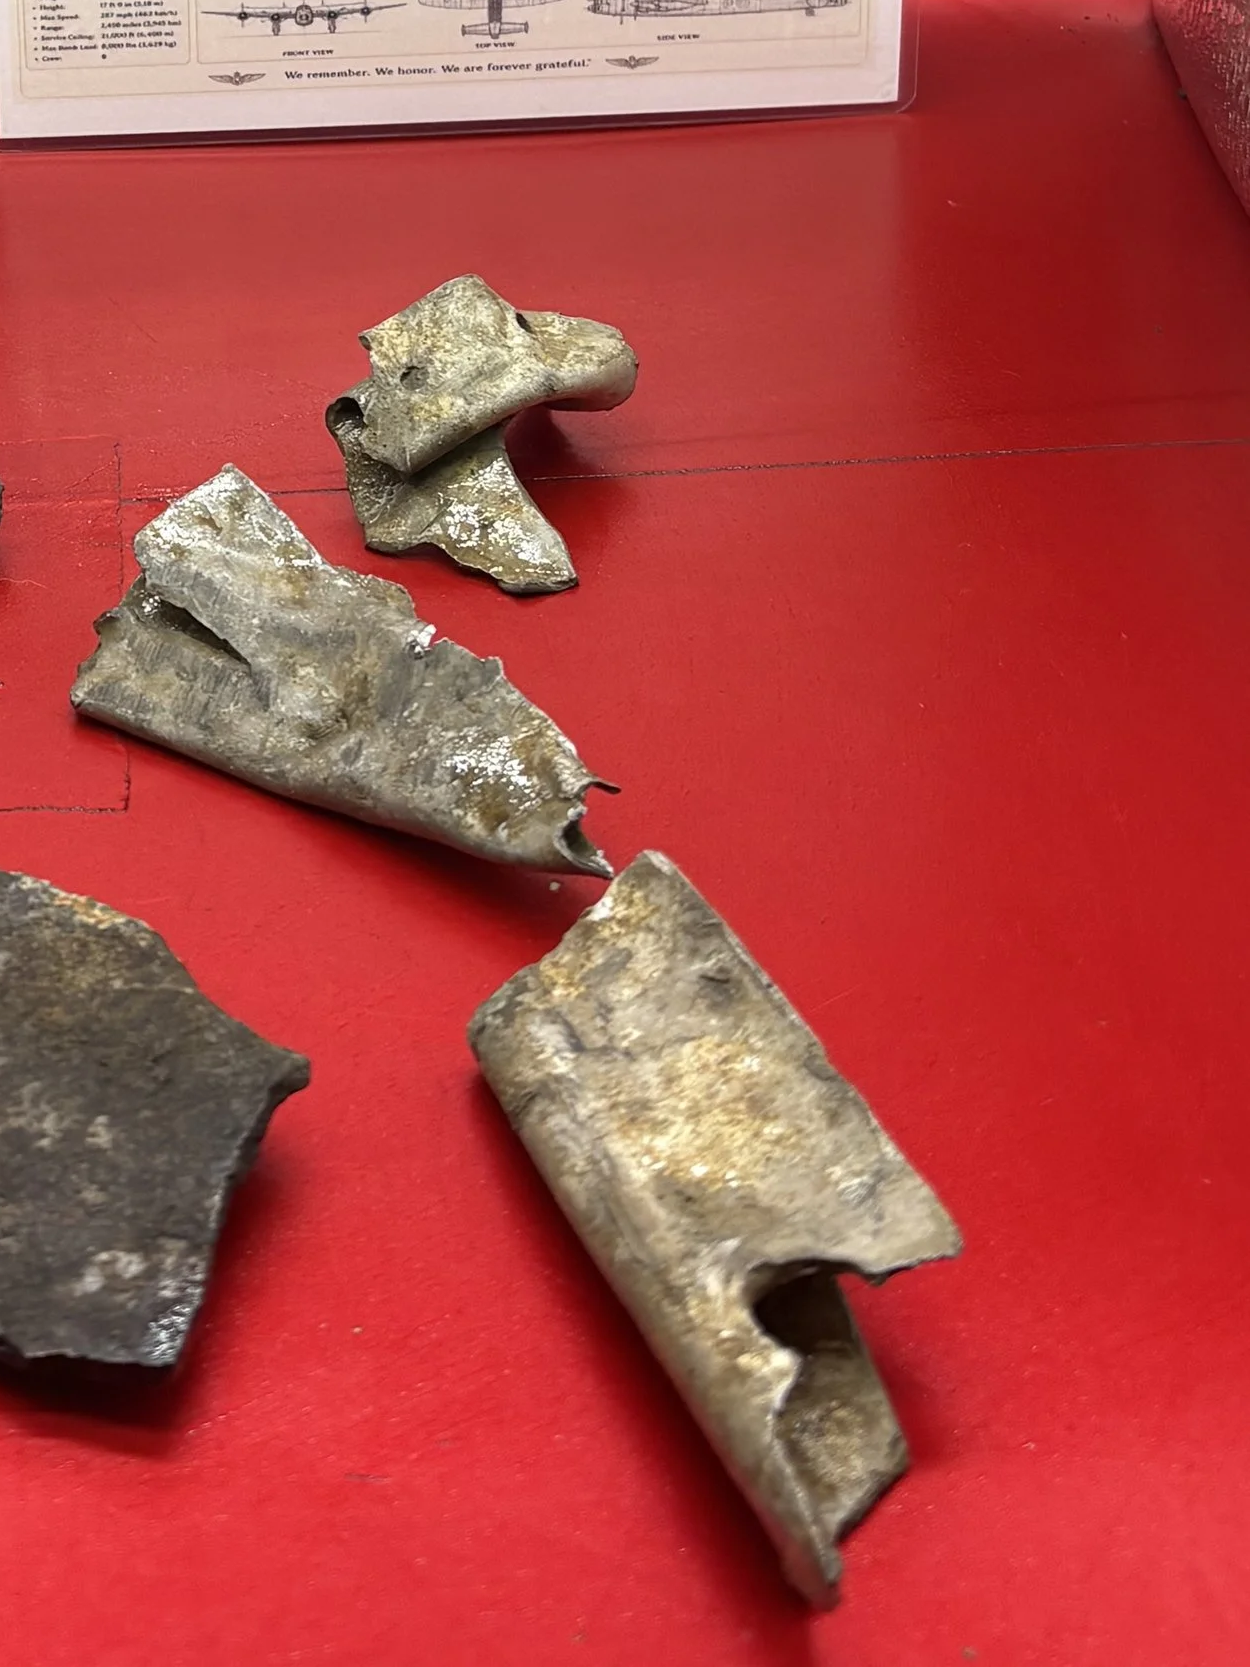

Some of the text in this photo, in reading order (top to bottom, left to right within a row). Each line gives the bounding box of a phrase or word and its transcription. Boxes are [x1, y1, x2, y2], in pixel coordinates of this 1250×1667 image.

[284, 70, 303, 79] We
[306, 68, 370, 78] remember.
[374, 67, 393, 75] We
[397, 66, 435, 75] honor.
[441, 64, 459, 73] We
[487, 62, 531, 71] forever
